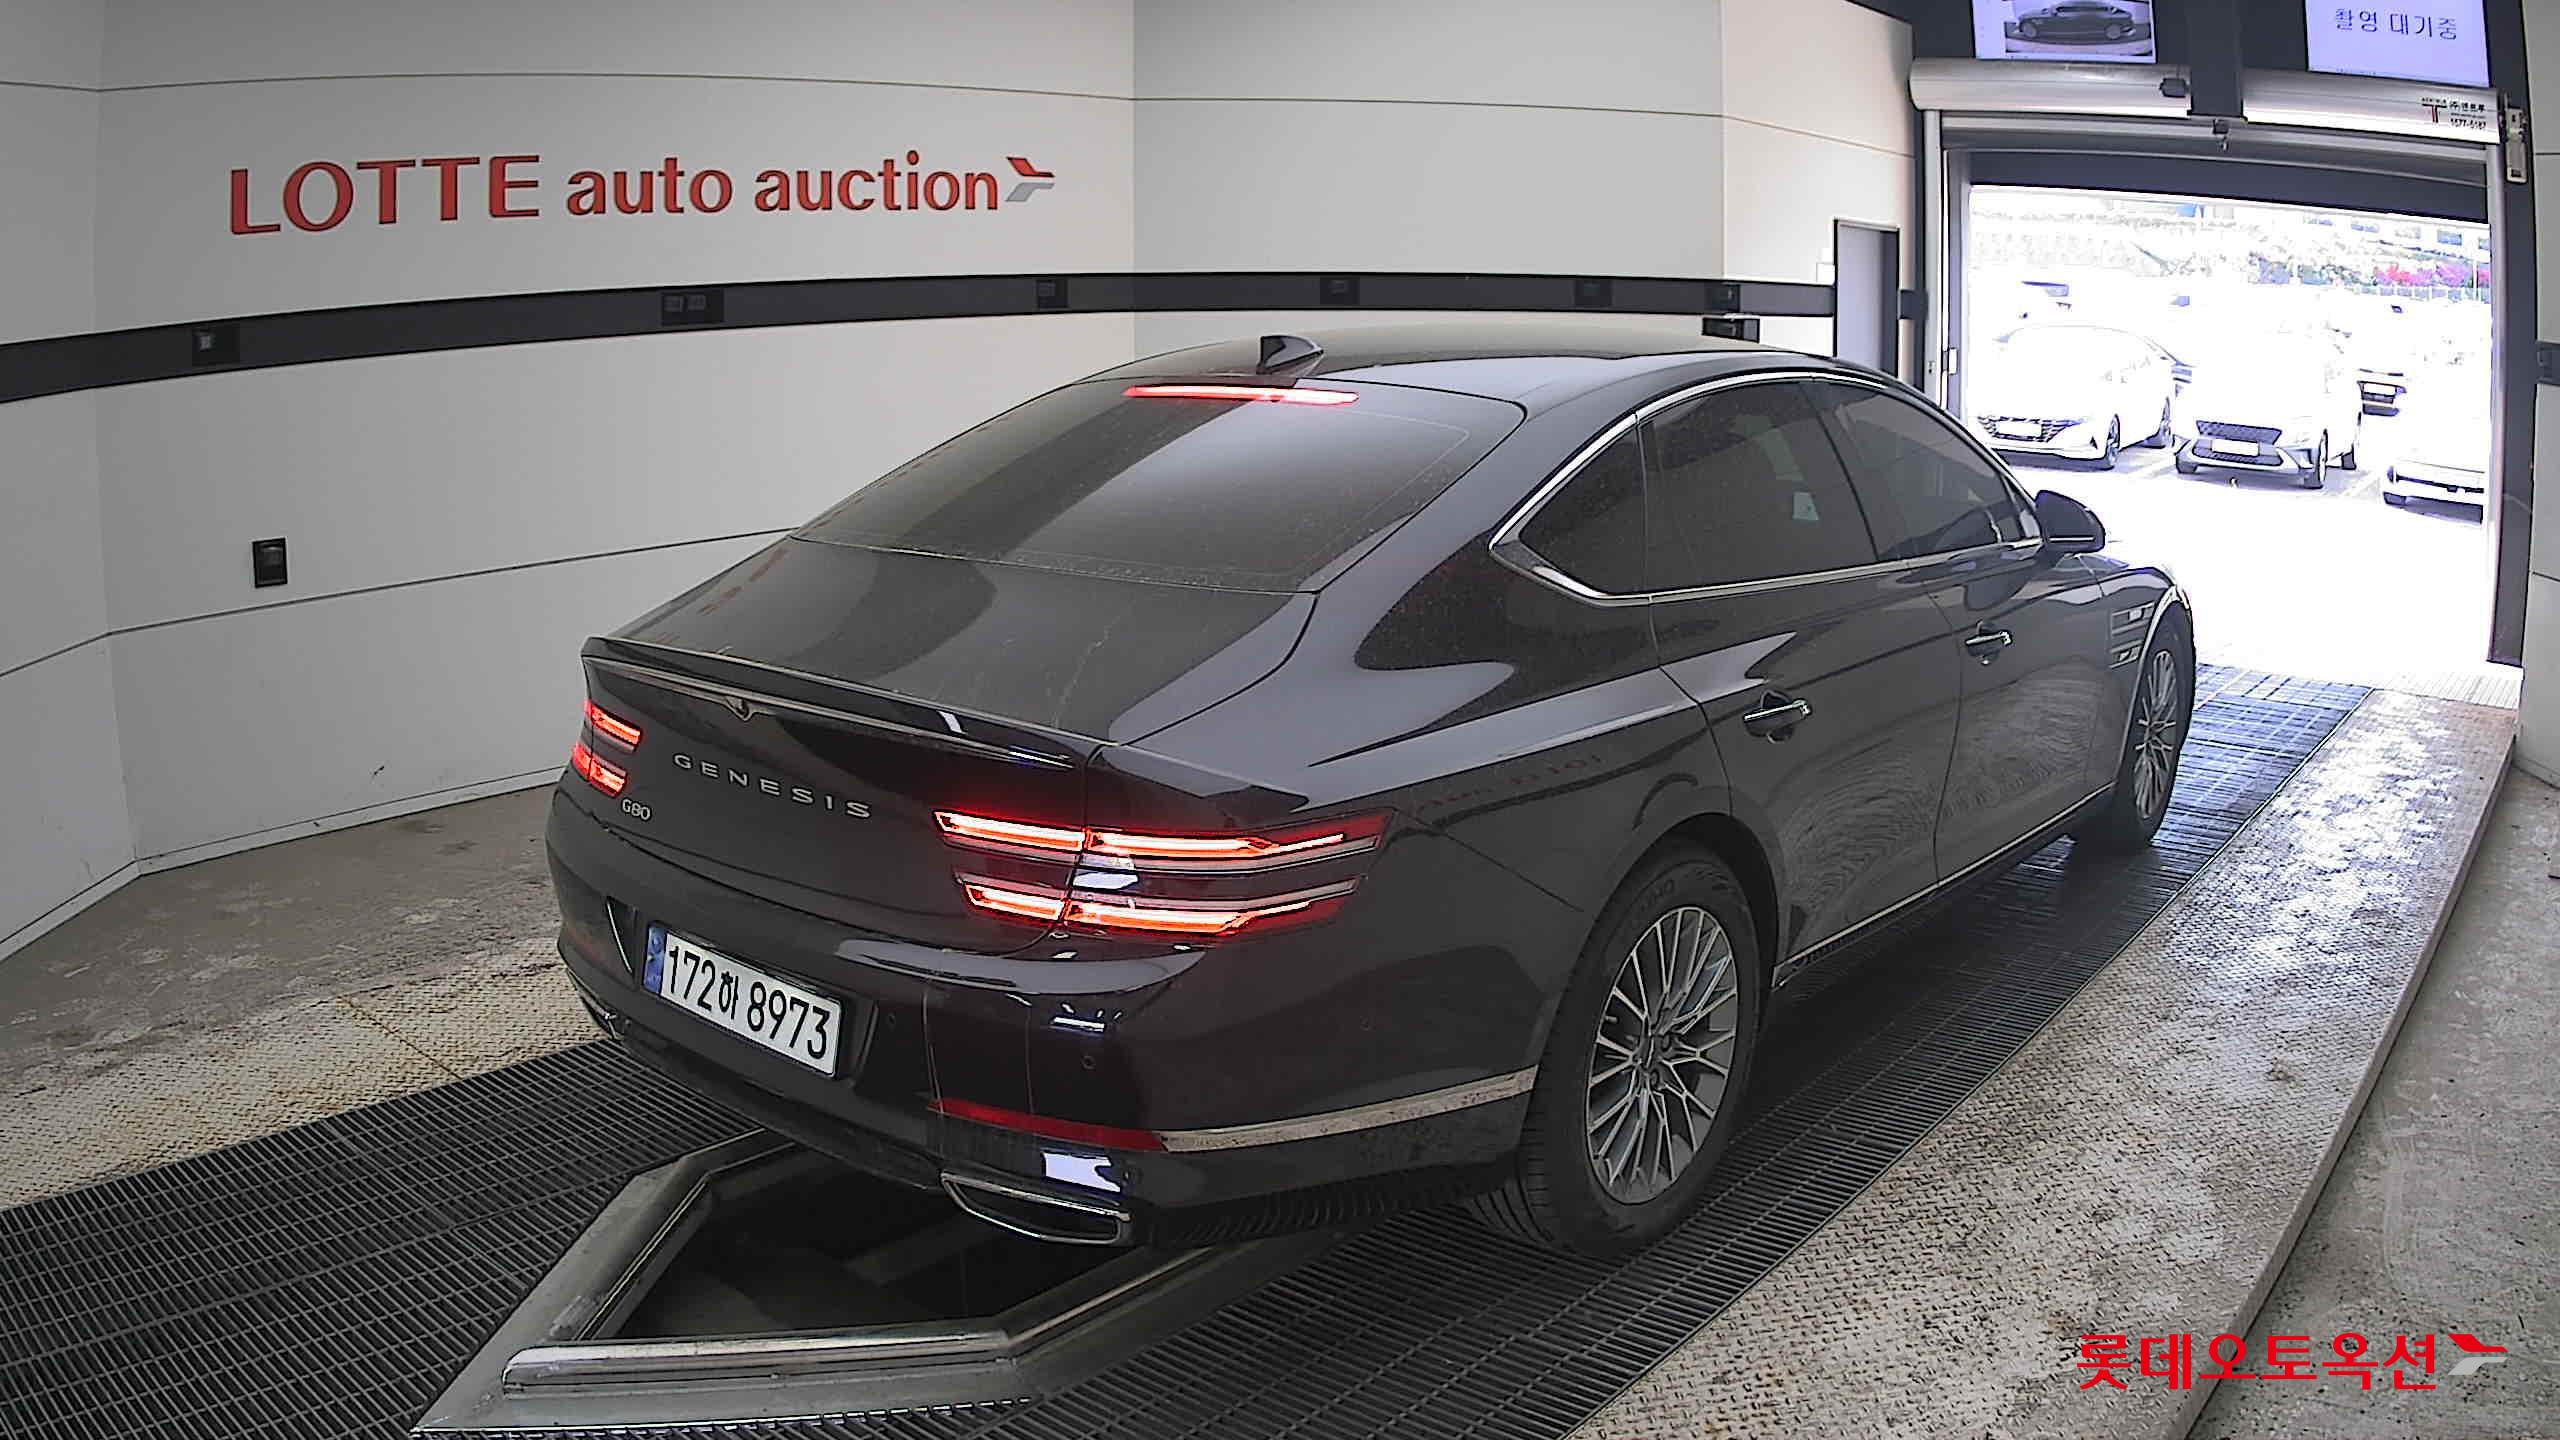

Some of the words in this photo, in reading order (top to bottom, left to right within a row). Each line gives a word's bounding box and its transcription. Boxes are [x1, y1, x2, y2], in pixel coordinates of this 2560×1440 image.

[2390, 13, 2457, 40] 대기중
[230, 155, 540, 235] LOTTE
[567, 158, 734, 215] auto
[755, 150, 999, 212] auction
[621, 799, 651, 821] G80
[673, 753, 871, 819] GENESIS
[669, 946, 739, 1020] 172하
[747, 981, 830, 1059] 8973
